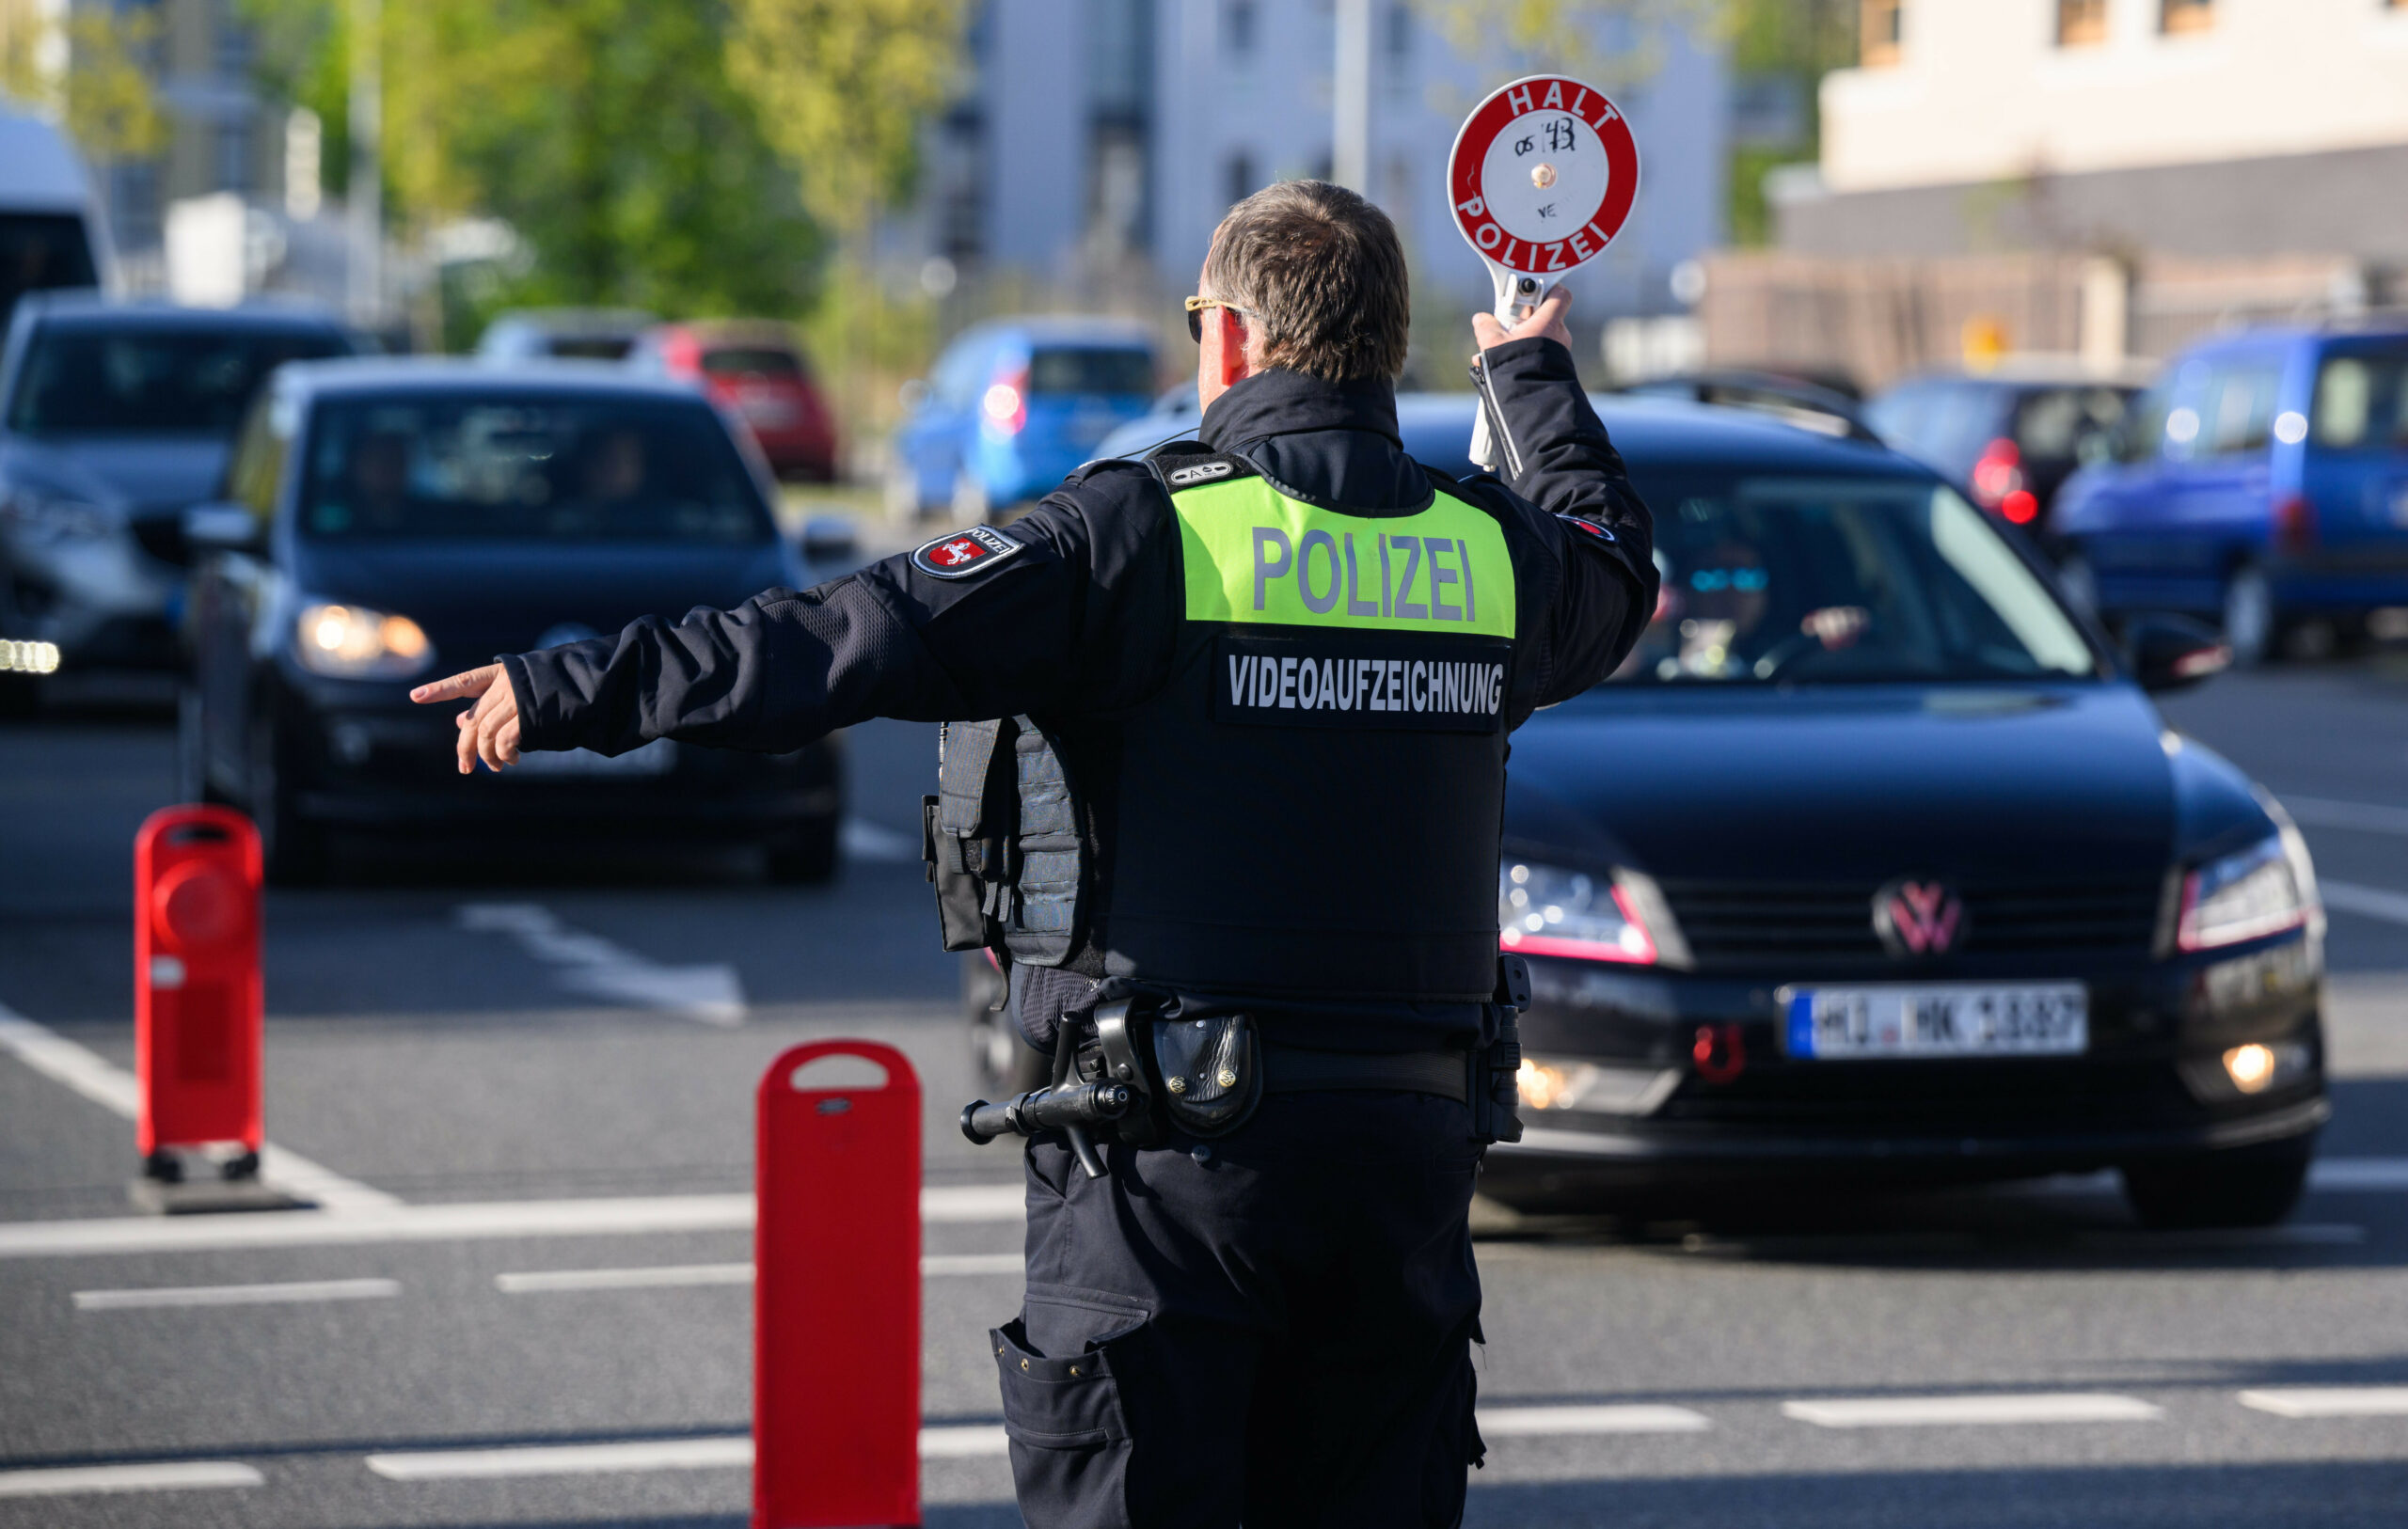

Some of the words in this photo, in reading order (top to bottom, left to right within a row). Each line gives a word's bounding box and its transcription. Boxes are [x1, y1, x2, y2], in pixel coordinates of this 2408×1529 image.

[1507, 81, 1619, 131] HALT
[1457, 195, 1609, 272] POLIZEI
[1252, 527, 1476, 623] POLIZEI
[1228, 654, 1503, 716] VIDEOAUFZEICHNUNG
